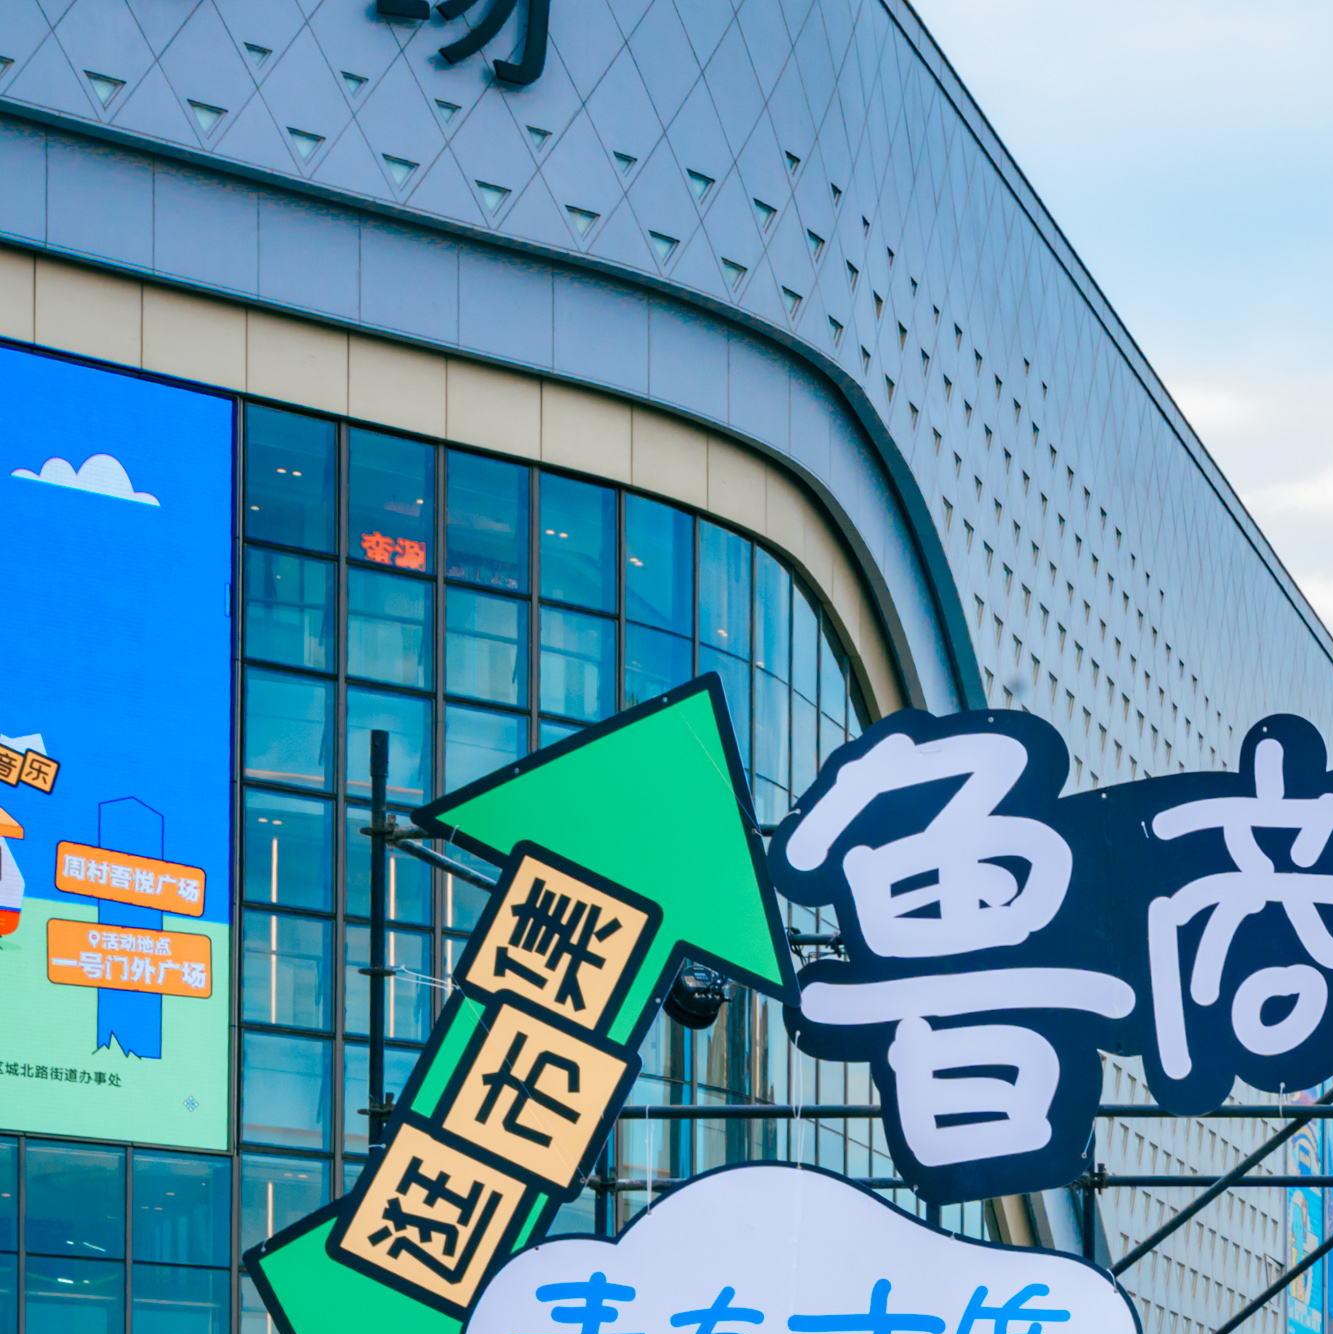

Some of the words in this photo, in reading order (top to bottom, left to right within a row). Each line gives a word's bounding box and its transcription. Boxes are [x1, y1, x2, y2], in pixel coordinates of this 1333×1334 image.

[62, 854, 201, 903] 周村吾悦广场
[101, 930, 172, 956] 活动地点
[52, 952, 207, 990] 一号门外广场
[368, 877, 623, 1284] 逛市集
